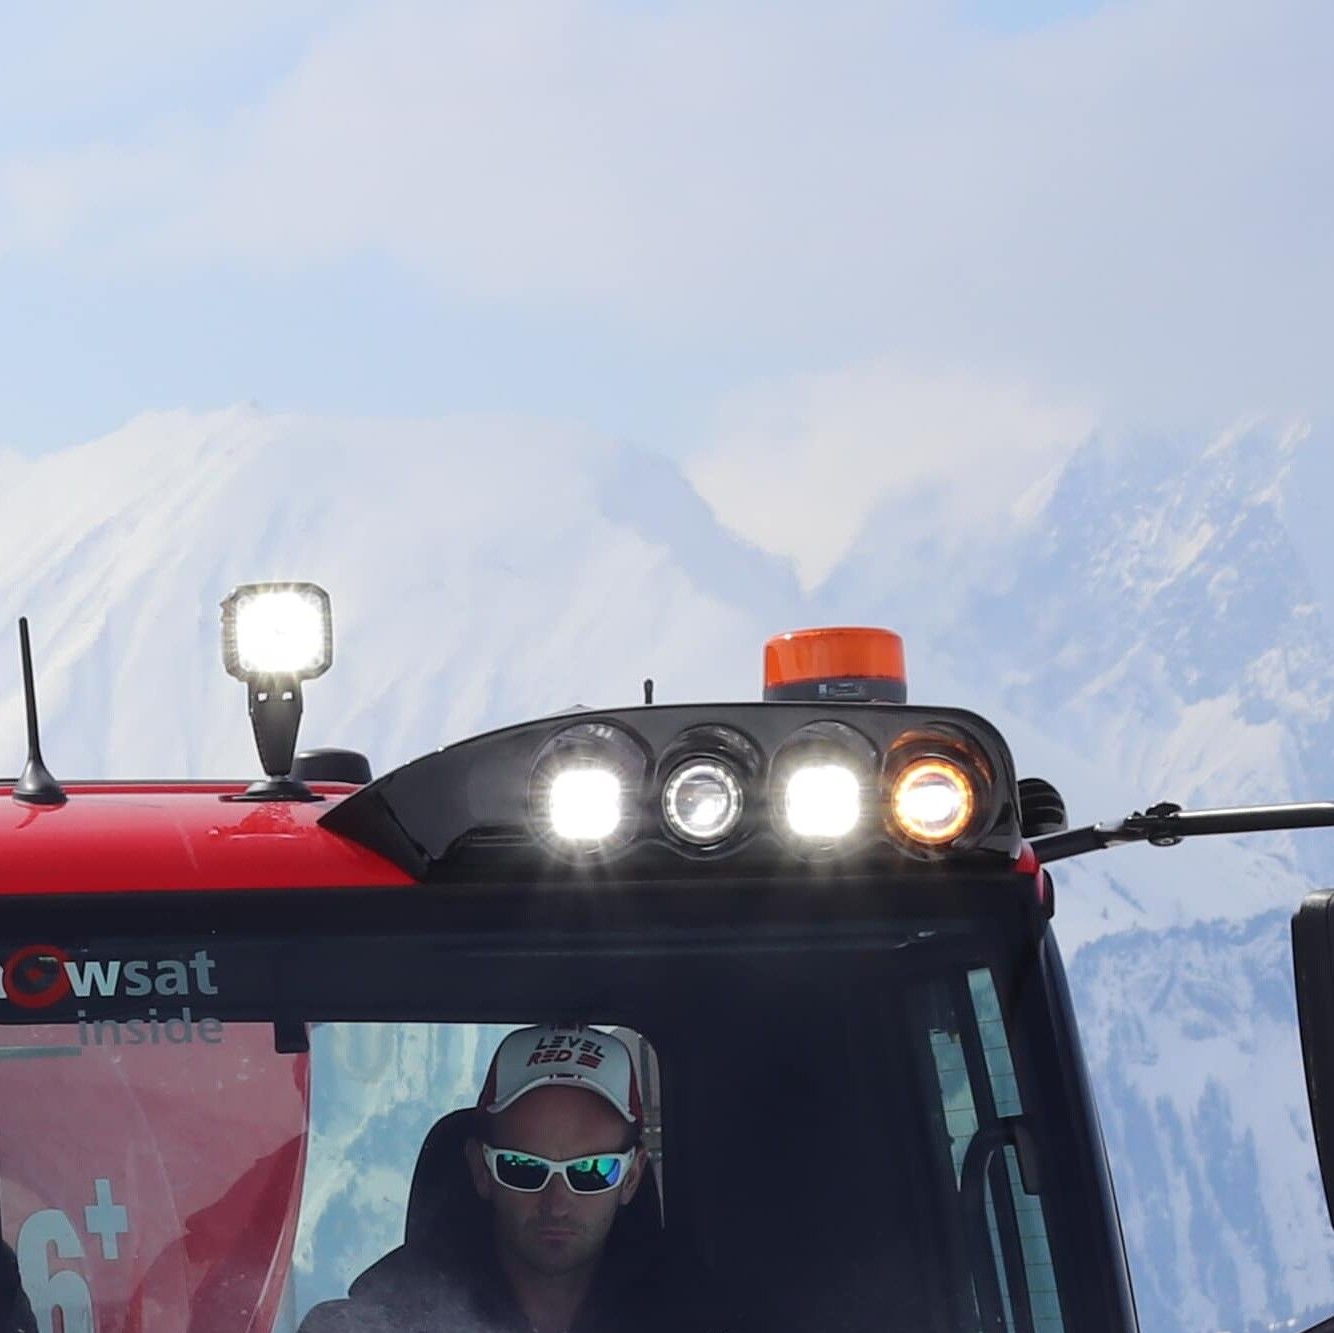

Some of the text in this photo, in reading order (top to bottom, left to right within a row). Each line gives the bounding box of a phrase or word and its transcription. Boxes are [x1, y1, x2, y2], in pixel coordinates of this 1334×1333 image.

[78, 1007, 224, 1046] inside
[526, 1050, 573, 1067] RED
[535, 1036, 606, 1059] LEVEL
